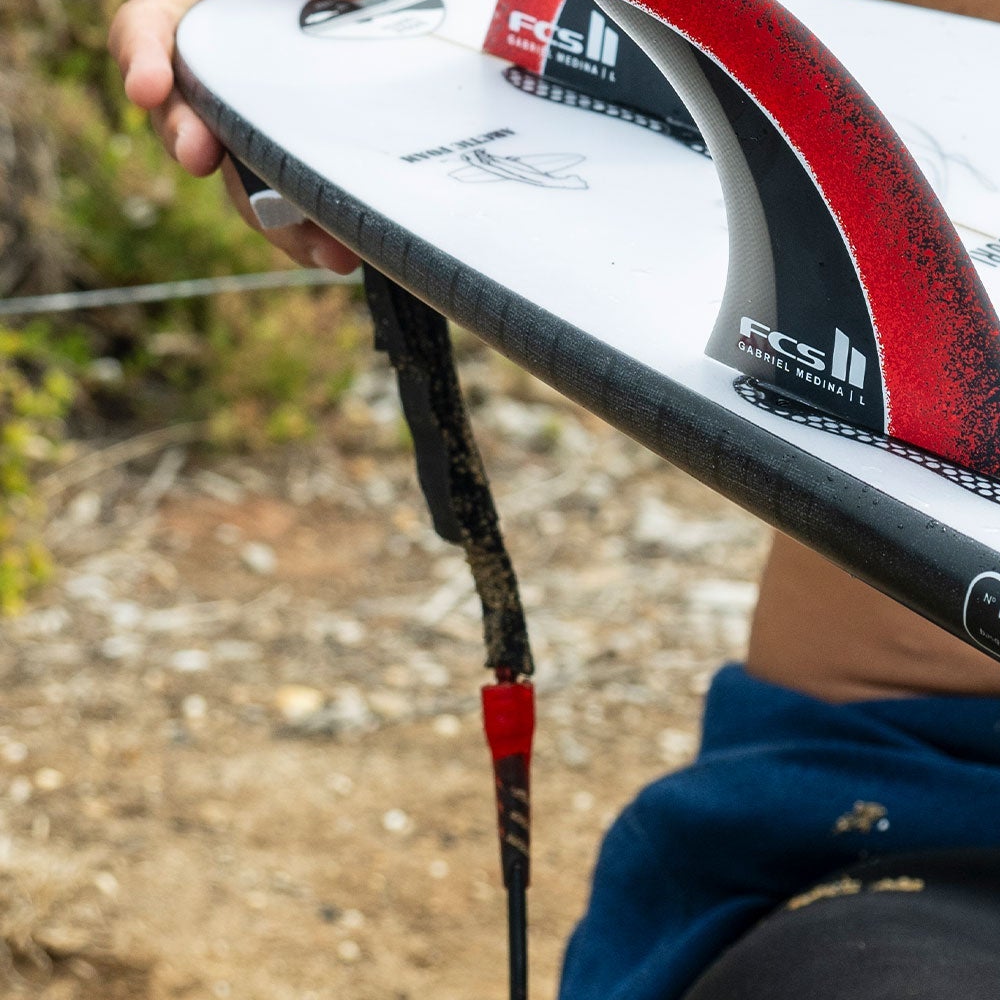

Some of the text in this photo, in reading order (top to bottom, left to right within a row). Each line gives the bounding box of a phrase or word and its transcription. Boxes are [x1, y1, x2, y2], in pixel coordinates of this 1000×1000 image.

[507, 33, 552, 60] GABRIEL
[556, 51, 599, 76] MEDINA
[508, 10, 585, 55] FCS
[400, 146, 453, 164] FOAM
[740, 316, 826, 371] FCS
[738, 341, 790, 373] GABRIEL
[796, 368, 844, 397] MEDINA
